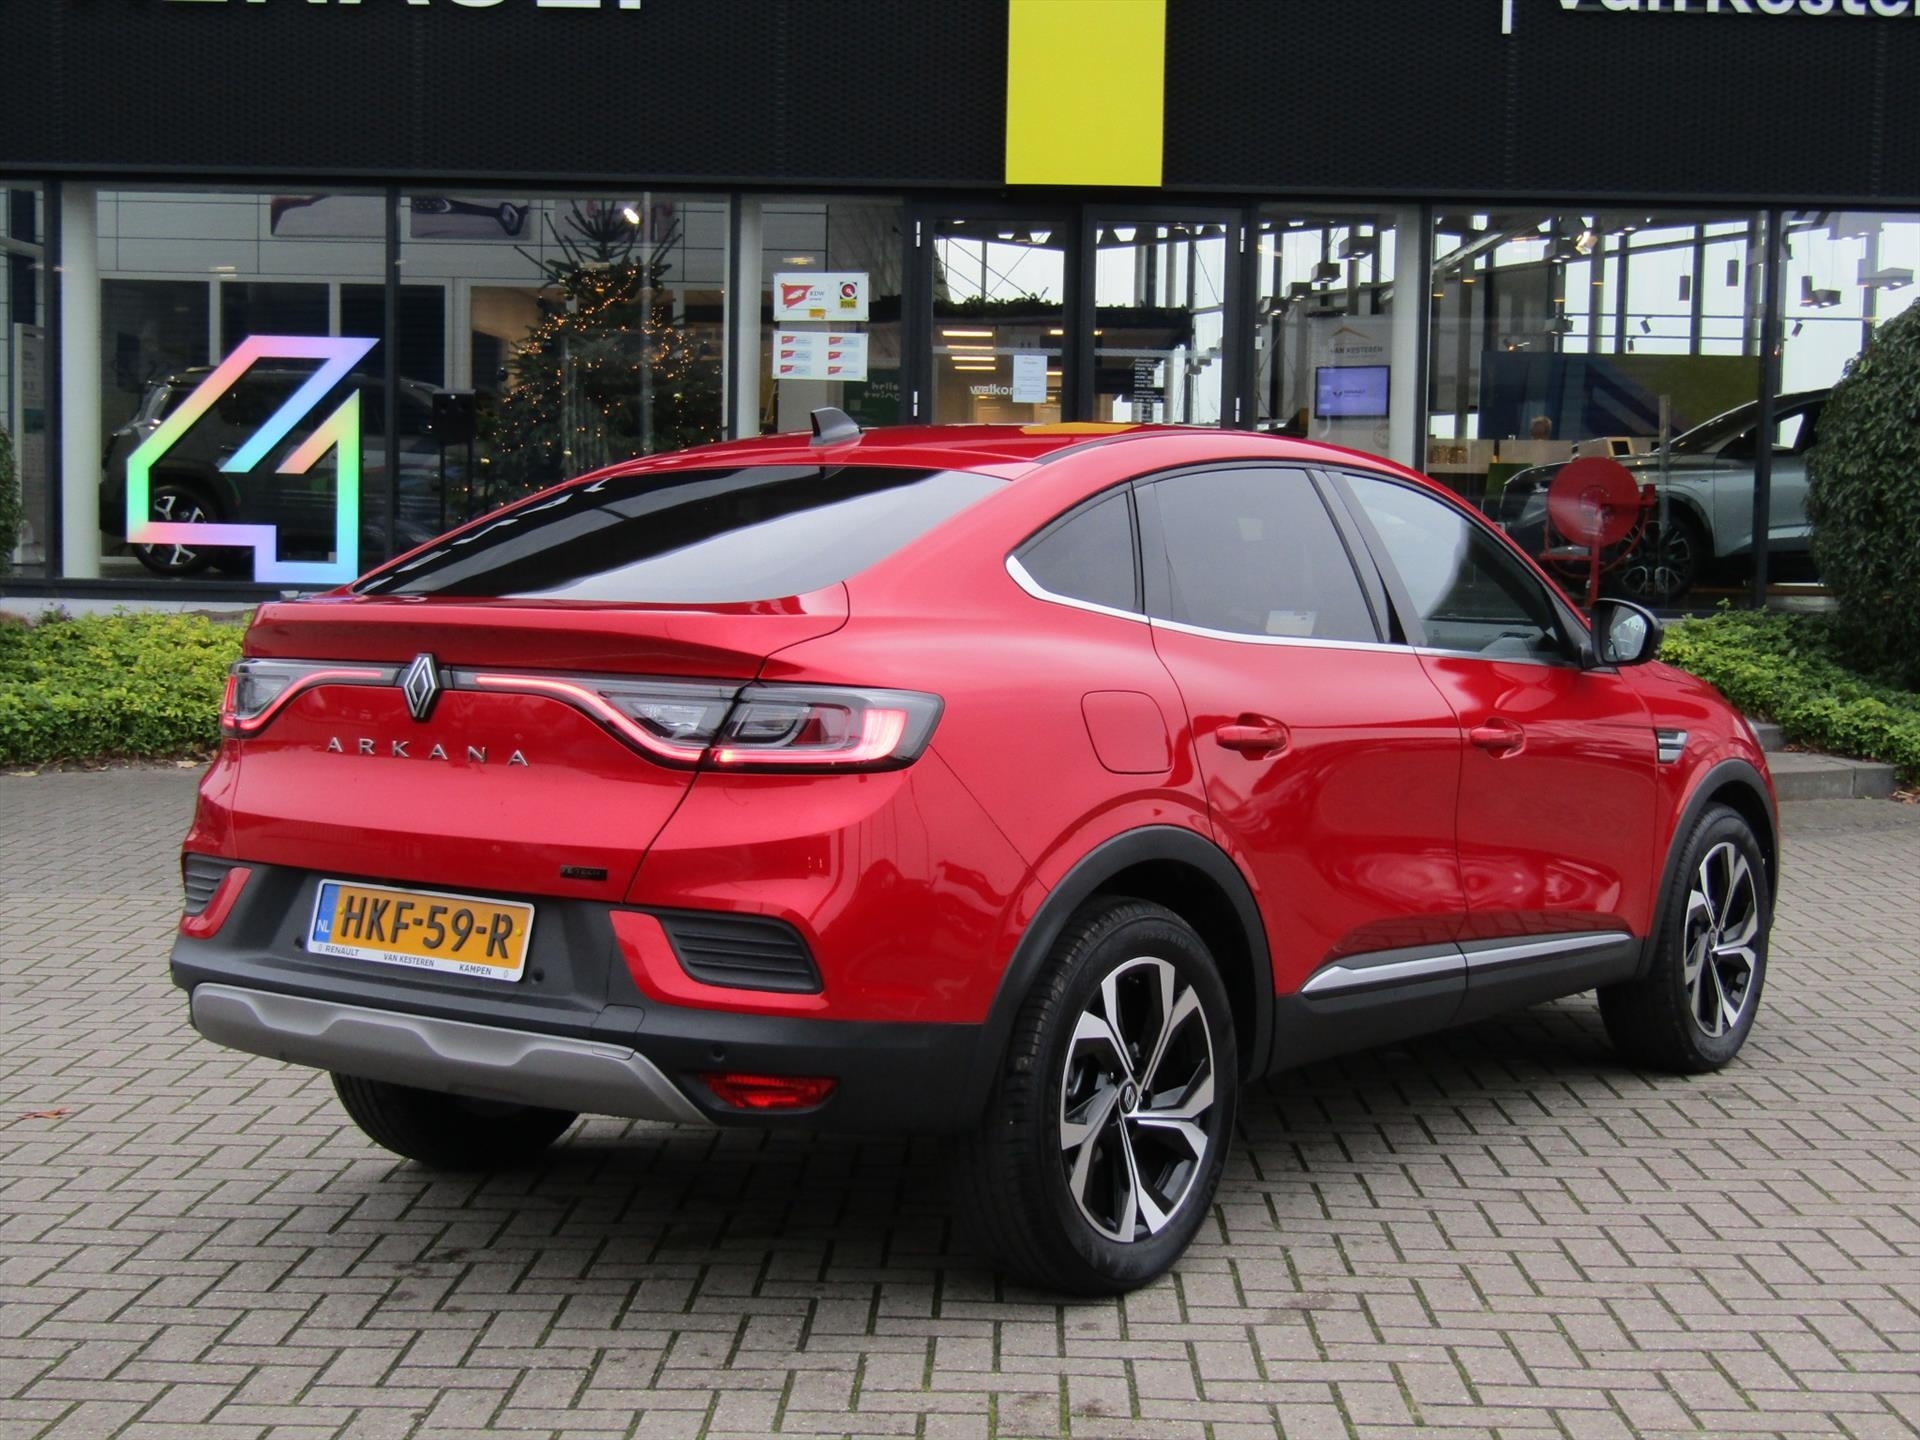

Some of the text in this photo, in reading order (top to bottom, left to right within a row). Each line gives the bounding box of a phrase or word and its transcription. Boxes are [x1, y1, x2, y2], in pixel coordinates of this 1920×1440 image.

[864, 390, 900, 402] twing
[327, 737, 529, 767] ARKANA
[317, 920, 330, 933] NL
[340, 896, 513, 959] HKF-59-R
[325, 945, 492, 976] RENAULT VAN KESTEREN KAMPEN
